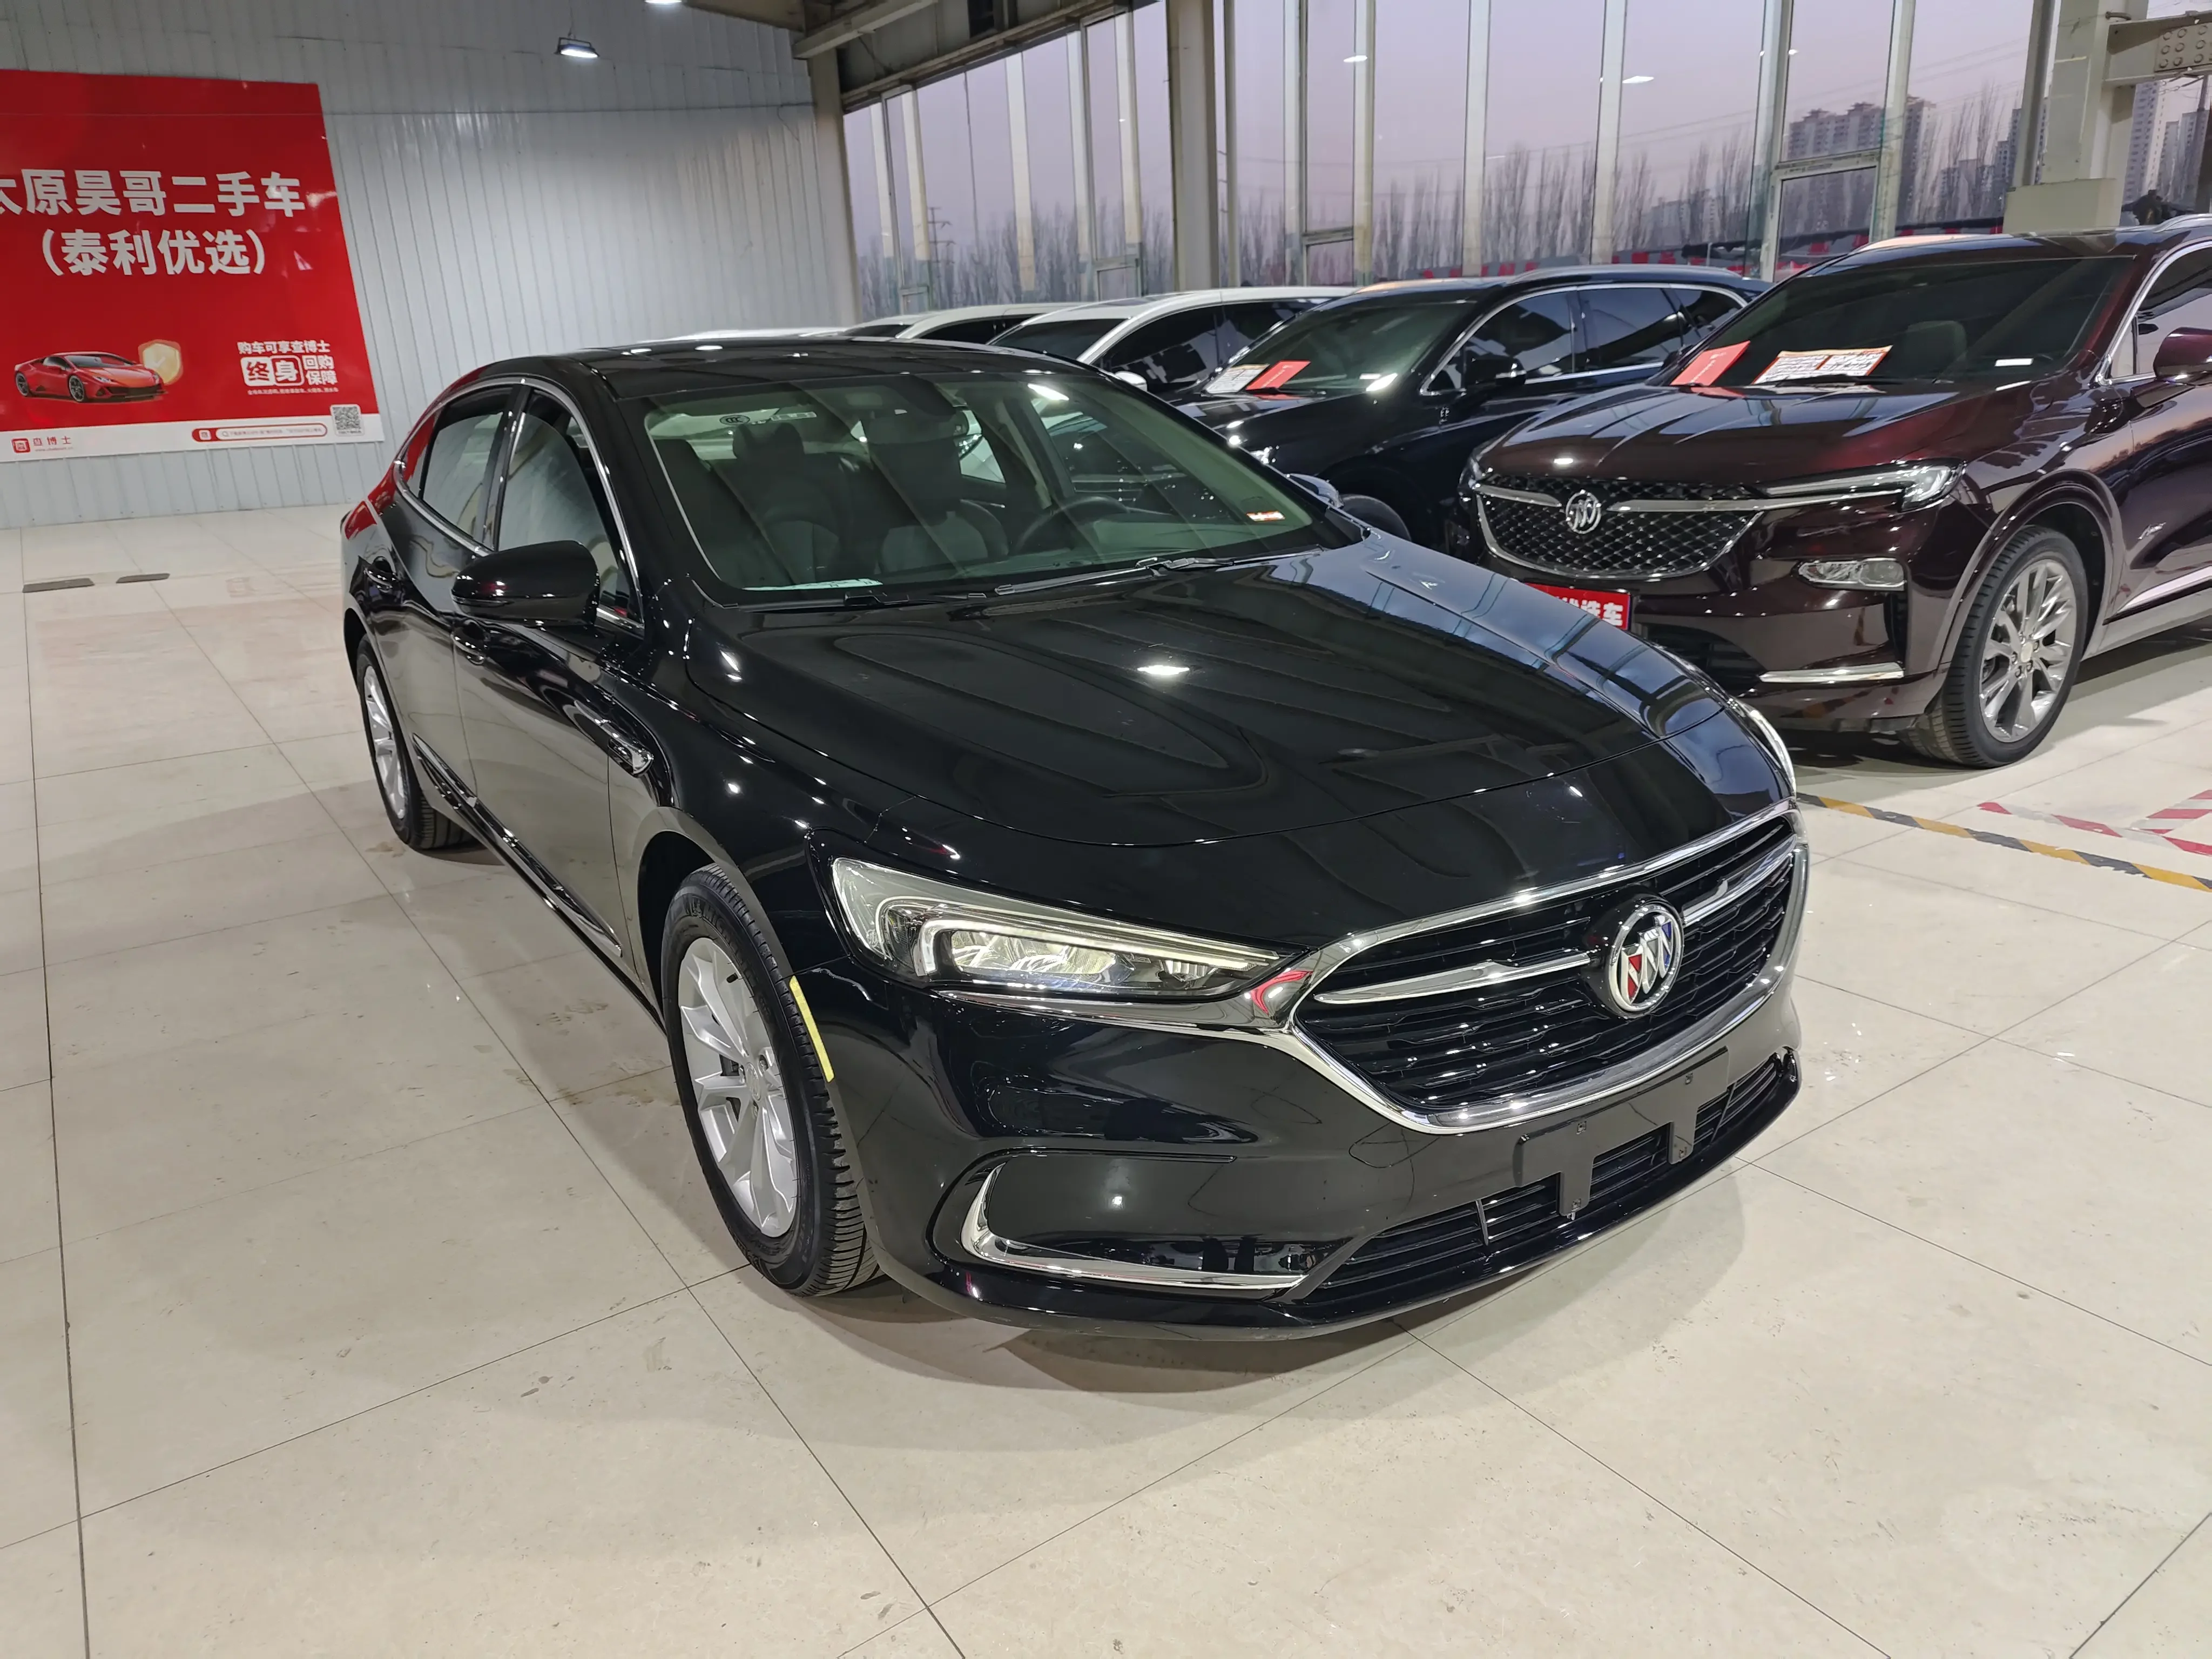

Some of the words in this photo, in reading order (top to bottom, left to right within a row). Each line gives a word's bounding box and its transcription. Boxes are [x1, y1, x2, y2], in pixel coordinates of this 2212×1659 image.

[42, 228, 265, 276] (泰利优选)
[237, 340, 331, 354] 购车可享查博士
[302, 355, 334, 369] 回购
[246, 360, 298, 381] 终身
[306, 370, 338, 385] 保障
